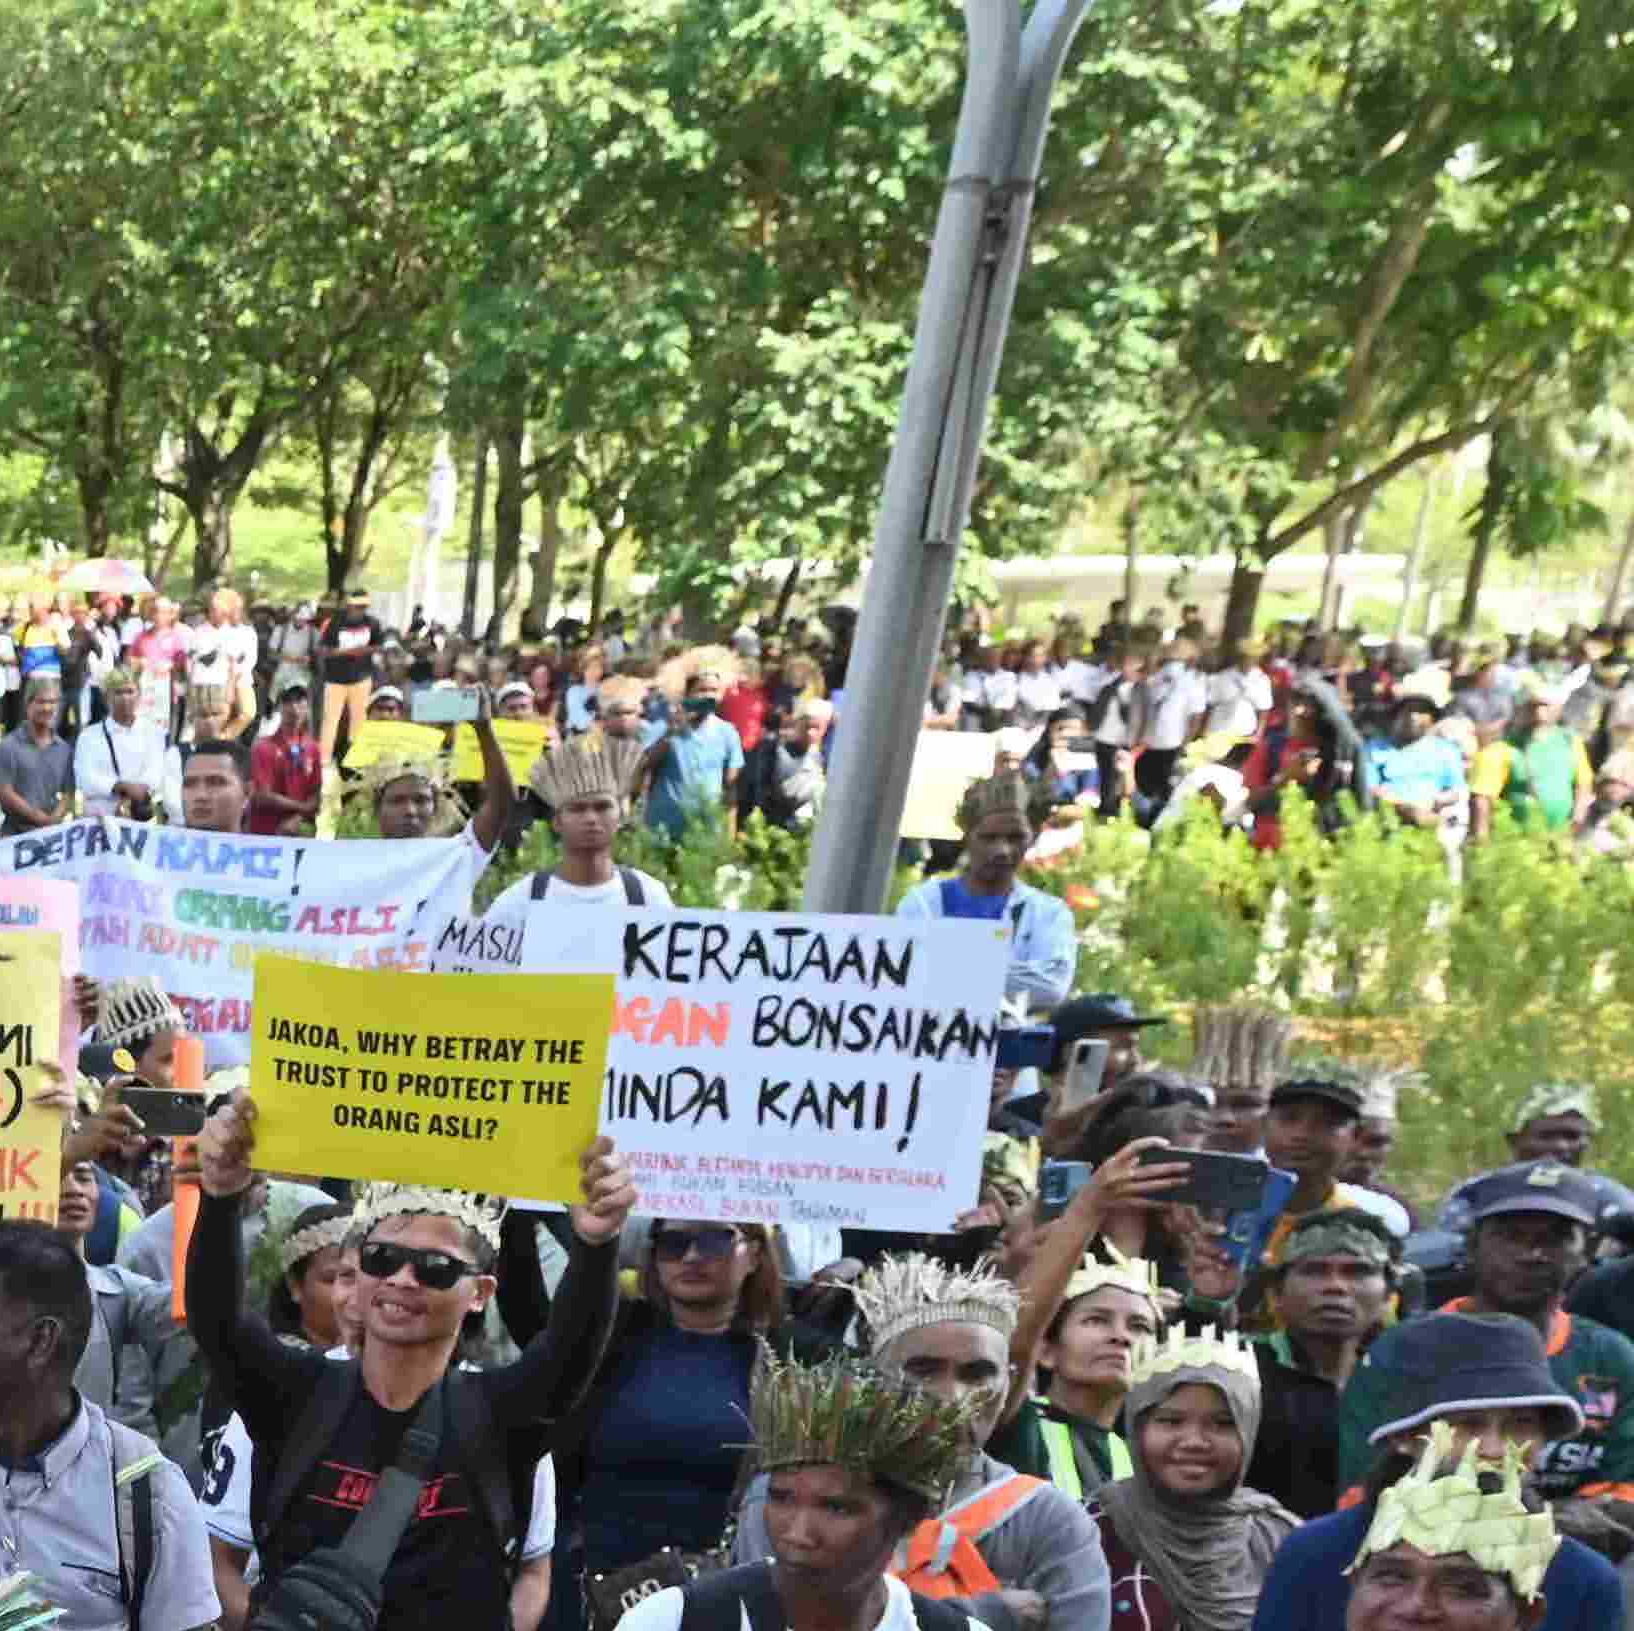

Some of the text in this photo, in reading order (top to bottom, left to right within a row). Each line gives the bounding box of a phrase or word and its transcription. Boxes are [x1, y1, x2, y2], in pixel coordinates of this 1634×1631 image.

[13, 824, 147, 871] DEPAN
[172, 888, 292, 933] ORANG
[623, 920, 912, 989] KERAJAAN
[267, 1017, 584, 1065] JAKOA, WHY BETRAY THE
[609, 989, 1000, 1062] GAN BONSAIKAN
[274, 1057, 570, 1106] TRUST TO PROTECT THE
[334, 1103, 499, 1141] ORANG ASLI?
[603, 1069, 921, 1152] INDA KAMI!
